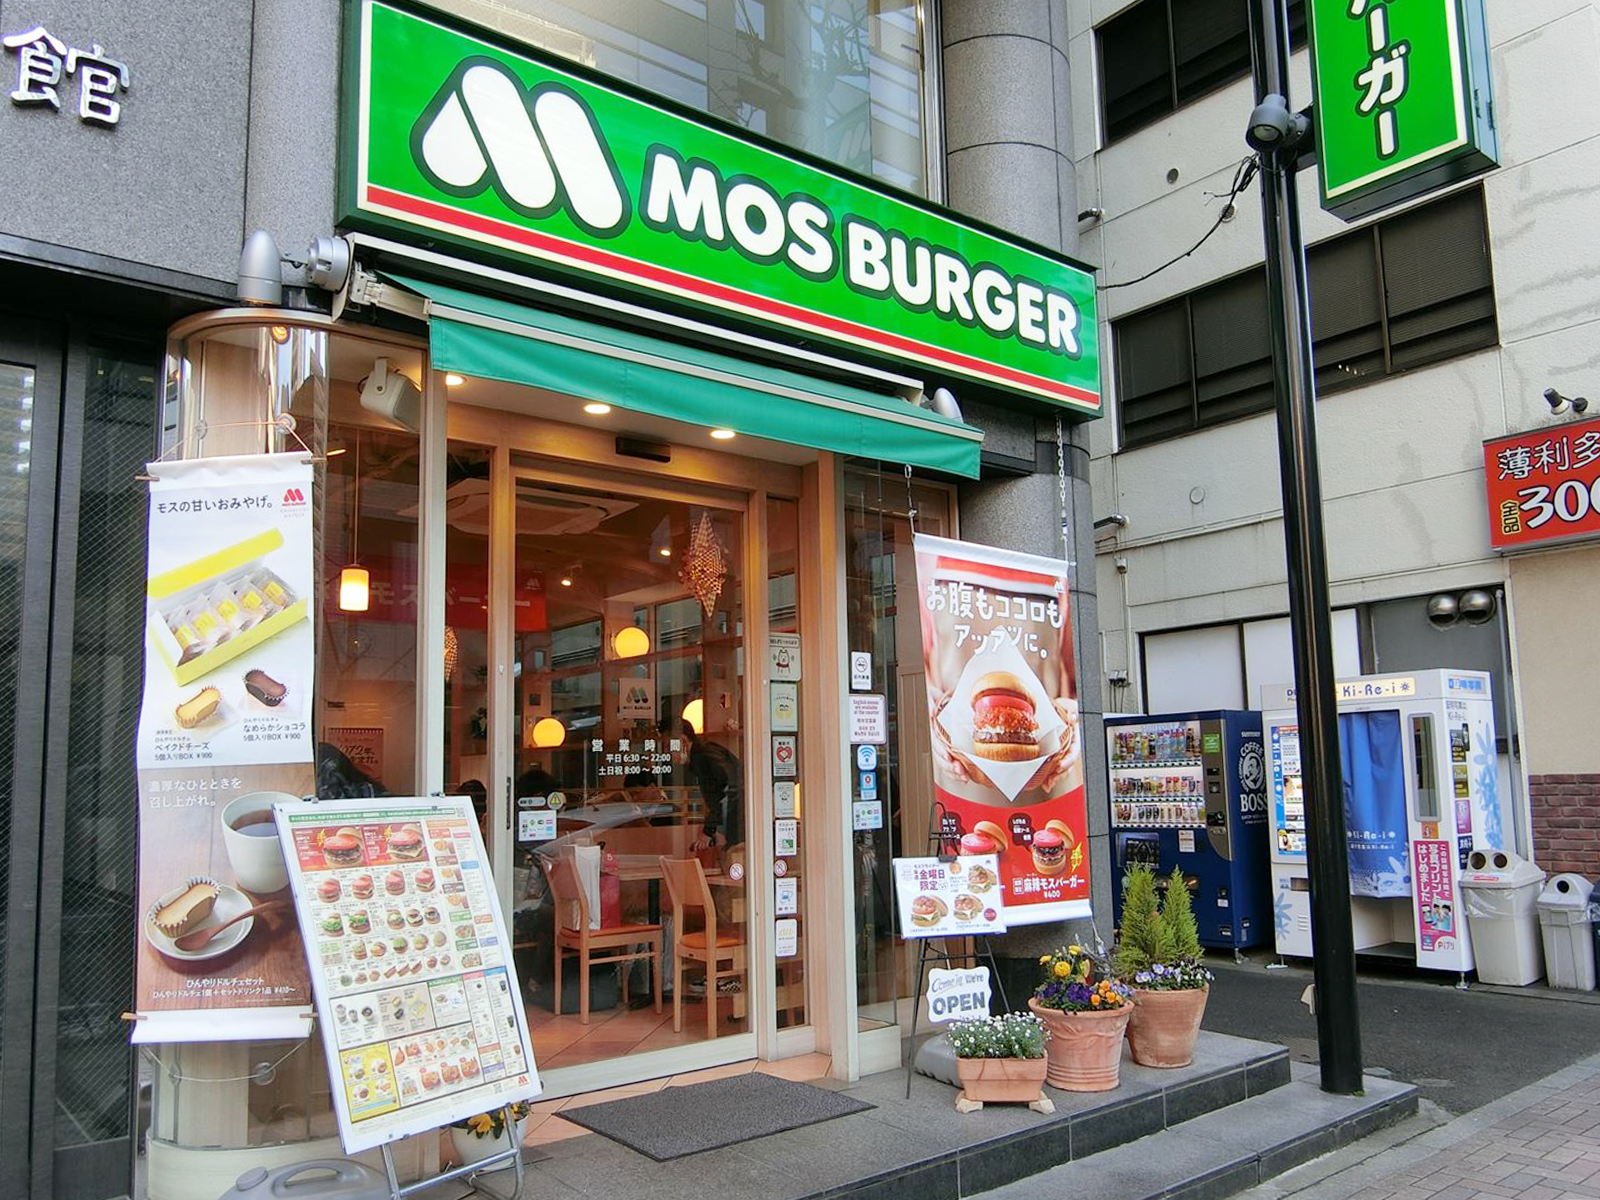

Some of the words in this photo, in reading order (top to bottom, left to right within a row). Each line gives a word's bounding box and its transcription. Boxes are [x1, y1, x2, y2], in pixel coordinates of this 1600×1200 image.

[1350, 0, 1407, 156] ーガー
[645, 150, 835, 276] MOS
[847, 227, 1080, 356] BURGER
[156, 495, 273, 514] モスの甘いおみやげ。
[1517, 475, 1600, 529] 30
[925, 580, 1064, 629] お腹もココロも
[953, 624, 1049, 659] アツアツに。
[243, 722, 306, 733] なめらかショコラ
[591, 738, 681, 752] 営業時間
[1239, 741, 1264, 757] COFFEE
[606, 754, 622, 763] 平日
[623, 754, 640, 762] 6:30
[650, 753, 671, 762] 22:00
[598, 765, 623, 776] 土日祝
[148, 778, 242, 793] 濃厚なひとときを
[149, 795, 216, 809] 召し上がれ。
[919, 868, 945, 880] 金曜日
[1417, 843, 1431, 902] はじめました
[920, 880, 939, 892] 限定
[932, 991, 986, 1016] OPEN
